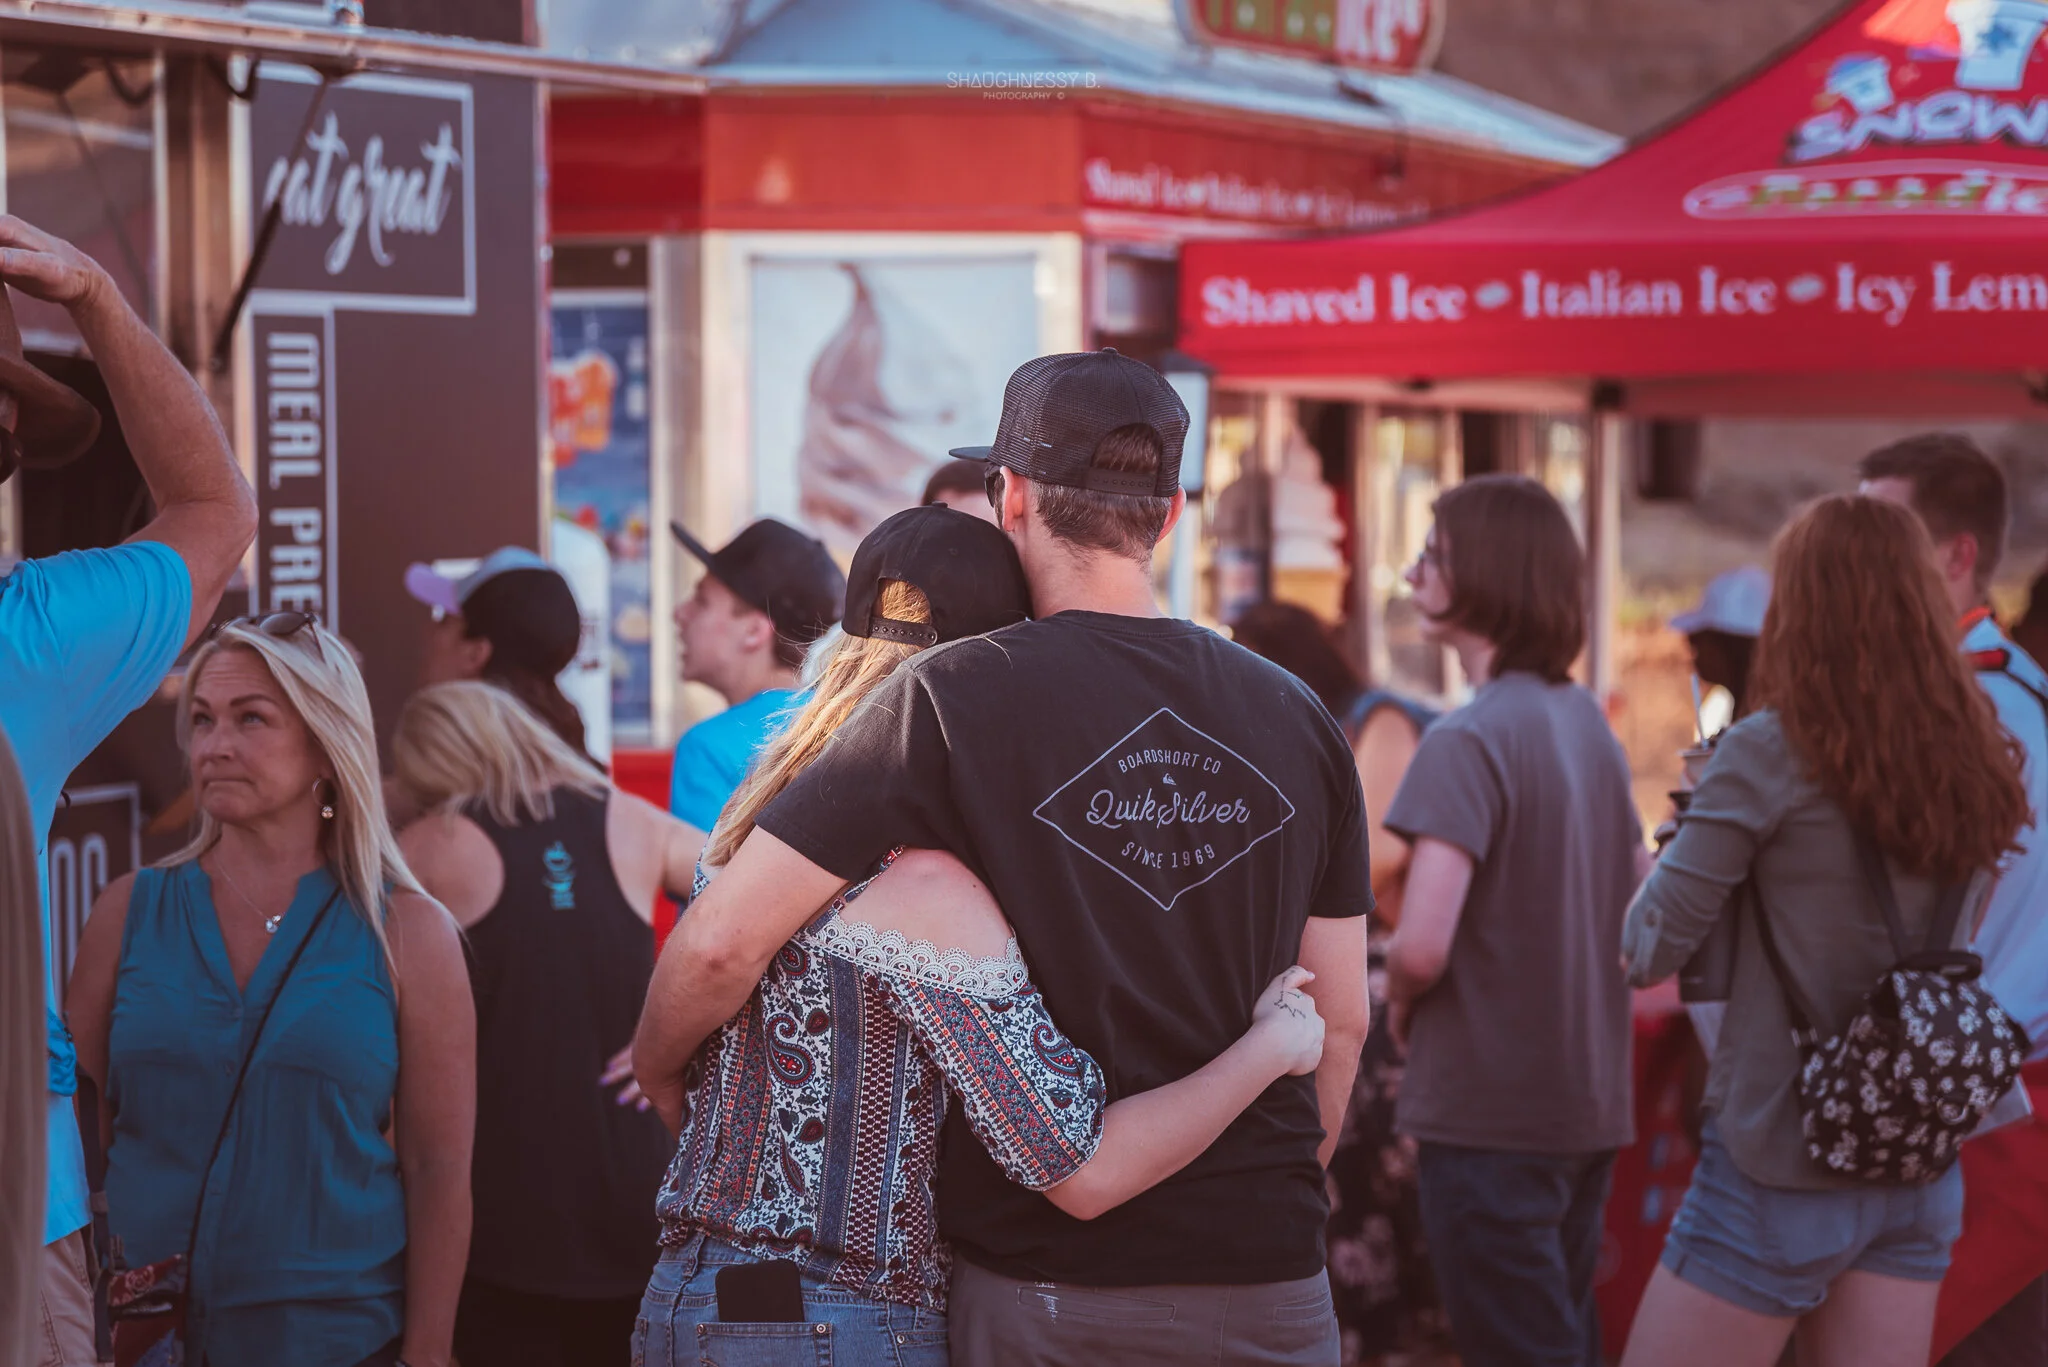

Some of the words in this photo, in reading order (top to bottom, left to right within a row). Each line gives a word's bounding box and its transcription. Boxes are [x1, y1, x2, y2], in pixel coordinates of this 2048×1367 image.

[324, 121, 463, 276] great
[1202, 274, 1376, 328] Shaved
[1389, 272, 1468, 323] Ice
[1521, 267, 1683, 319] Italian
[1700, 264, 1777, 316] Ice
[1836, 261, 1916, 327] Icy
[266, 331, 322, 491] MEAL
[1118, 749, 1200, 774] BOARDSHORT
[1202, 756, 1222, 775] CO
[1086, 787, 1251, 830] QuikSilver
[1121, 840, 1164, 870] SINCE
[1171, 843, 1216, 869] 1969
